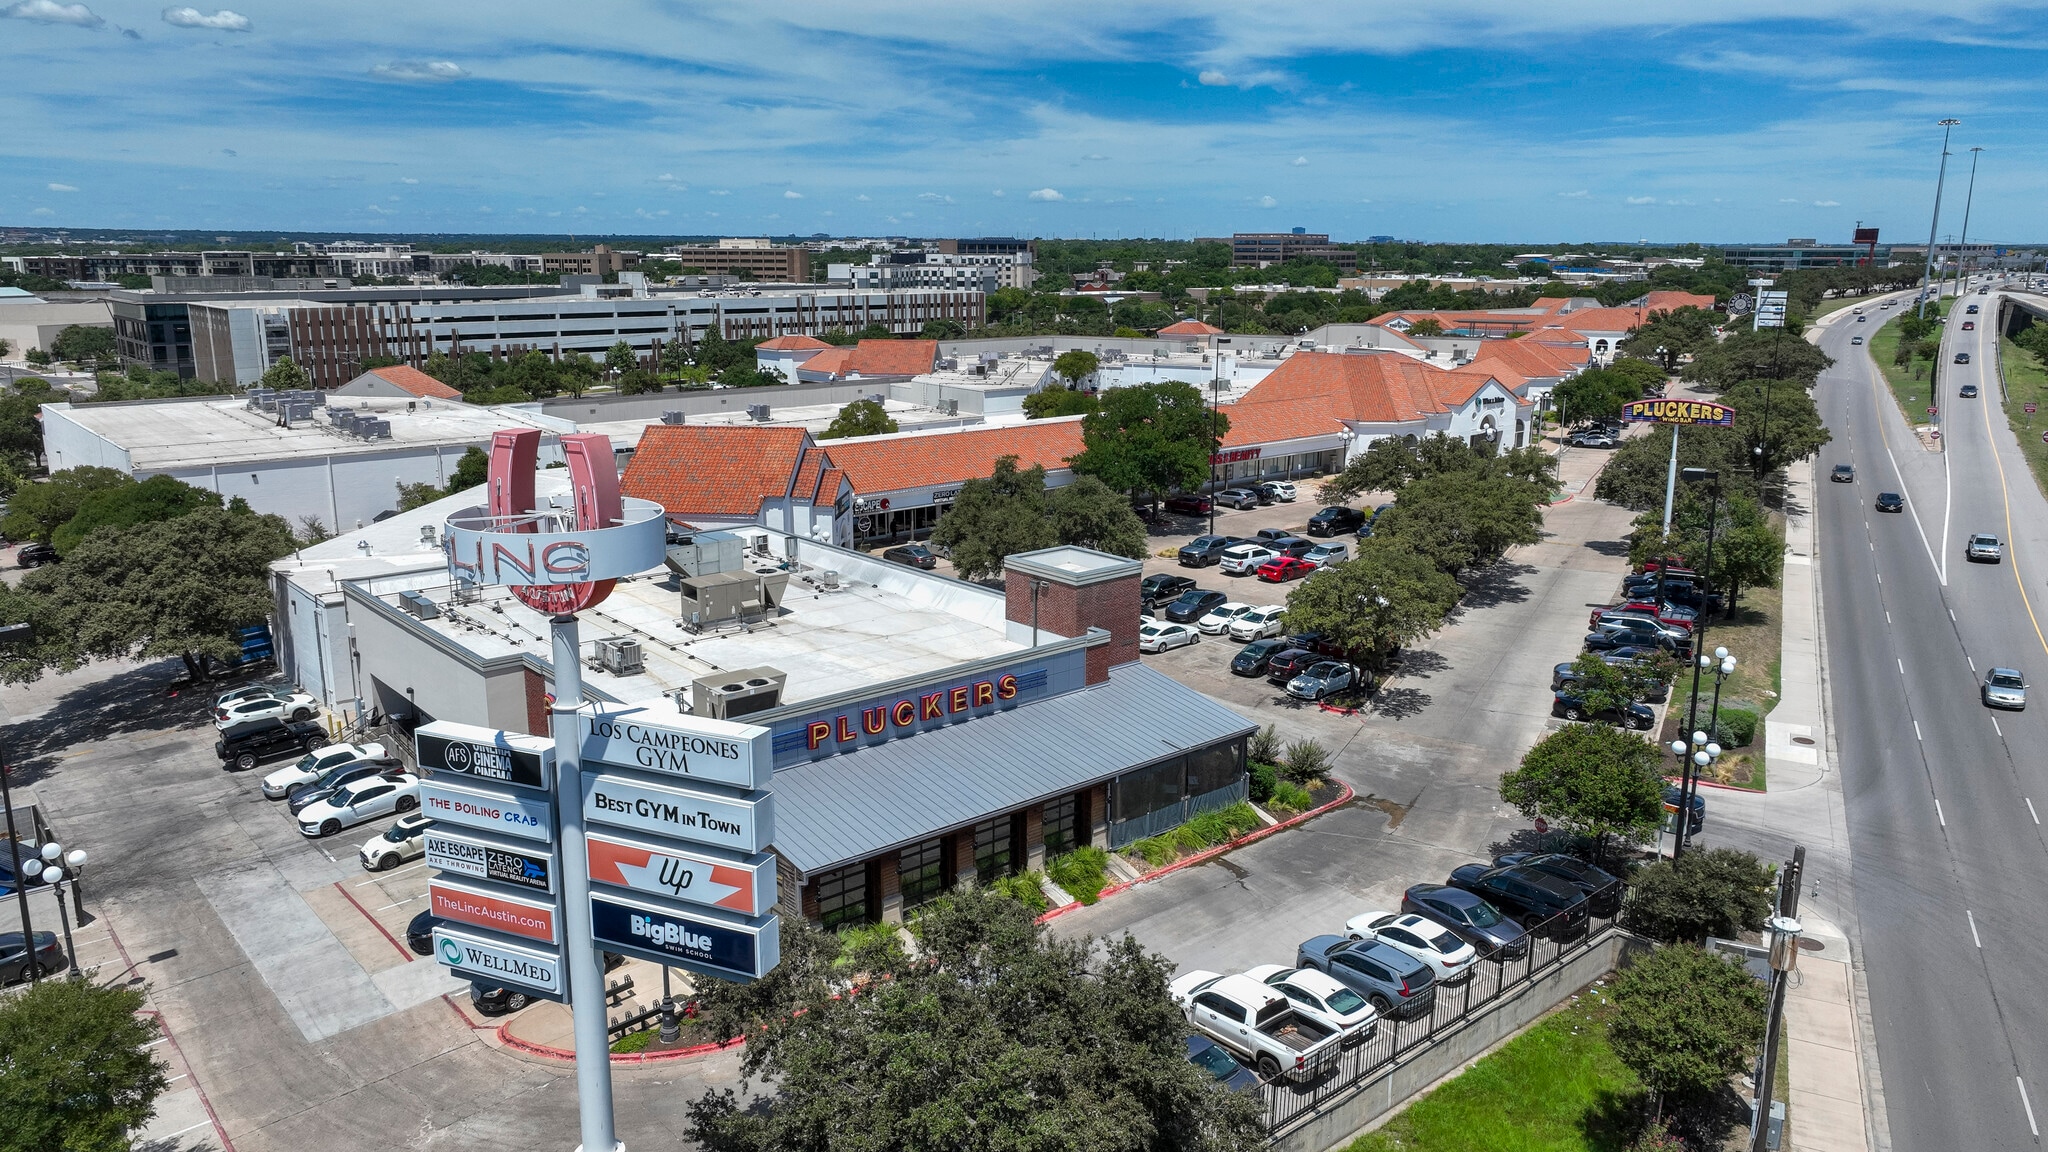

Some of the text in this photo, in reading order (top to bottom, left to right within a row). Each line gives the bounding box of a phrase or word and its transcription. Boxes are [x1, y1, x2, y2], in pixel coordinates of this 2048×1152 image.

[1632, 401, 1724, 421] PLUCKERS
[1230, 448, 1262, 462] BEAUTY
[450, 532, 587, 577] LINC
[521, 585, 575, 603] AUSTIN
[806, 674, 1018, 750] PLUCKERS
[589, 718, 739, 760] LOS CAMPEONES
[448, 748, 513, 771] AFS CINEMA
[636, 746, 690, 773] GYM
[429, 797, 538, 827] THE BOILING CRAB
[594, 792, 741, 836] BEST GYM IN TOWN
[428, 838, 484, 861] AXE ESCAPE
[488, 852, 523, 867] ZERO
[429, 857, 485, 873] AXE THROWING
[488, 862, 523, 876] LATENCY
[658, 857, 693, 895] Up
[488, 869, 547, 888] VIRTUAL REALITY ARENA
[437, 896, 546, 930] TheLincAustin.com
[630, 914, 712, 951] BigBlue
[466, 947, 552, 982] WELLMED
[665, 944, 713, 960] SWIM SCHOOL
